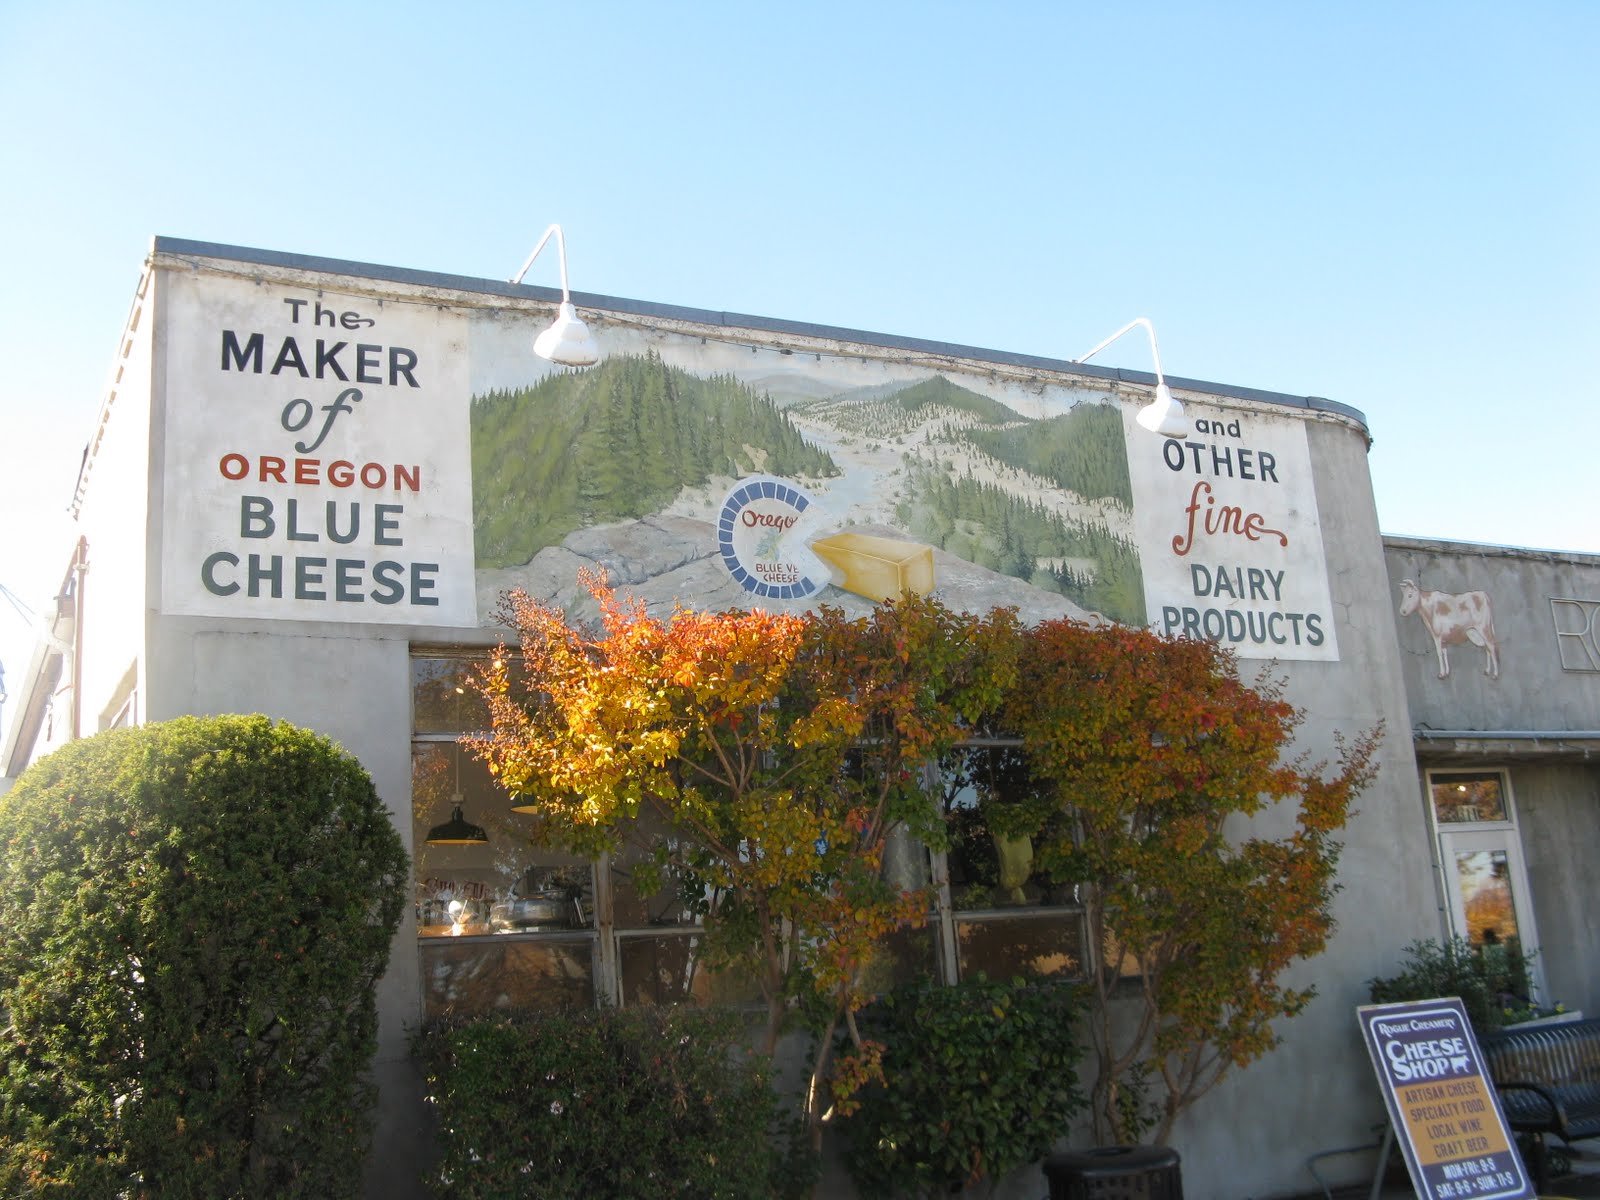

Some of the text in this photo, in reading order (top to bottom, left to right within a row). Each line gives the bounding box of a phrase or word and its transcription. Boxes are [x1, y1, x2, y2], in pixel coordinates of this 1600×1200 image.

[284, 298, 375, 330] The
[220, 329, 421, 388] MAKER
[280, 387, 364, 454] of
[1195, 418, 1242, 439] and
[219, 453, 421, 493] OREGON
[1162, 438, 1280, 484] OTHER
[240, 495, 404, 547] BLUE
[1172, 480, 1289, 557] fine
[201, 551, 440, 607] CHEESE
[755, 563, 783, 573] BLUE
[763, 573, 798, 583] CHEESE
[1190, 563, 1286, 602] DAIRY
[1162, 605, 1325, 648] PRODUCTS
[1378, 1018, 1456, 1038] ROGUE CREAMERY
[1385, 1037, 1467, 1063] CHEESE
[1392, 1057, 1449, 1081] SHOP
[1405, 1081, 1479, 1104] ARTISAN CHEESE
[1410, 1098, 1486, 1122] SPECIALTY FOOD
[1426, 1118, 1484, 1139] LOCAL WINE
[1433, 1136, 1489, 1158] CRAFT BEER
